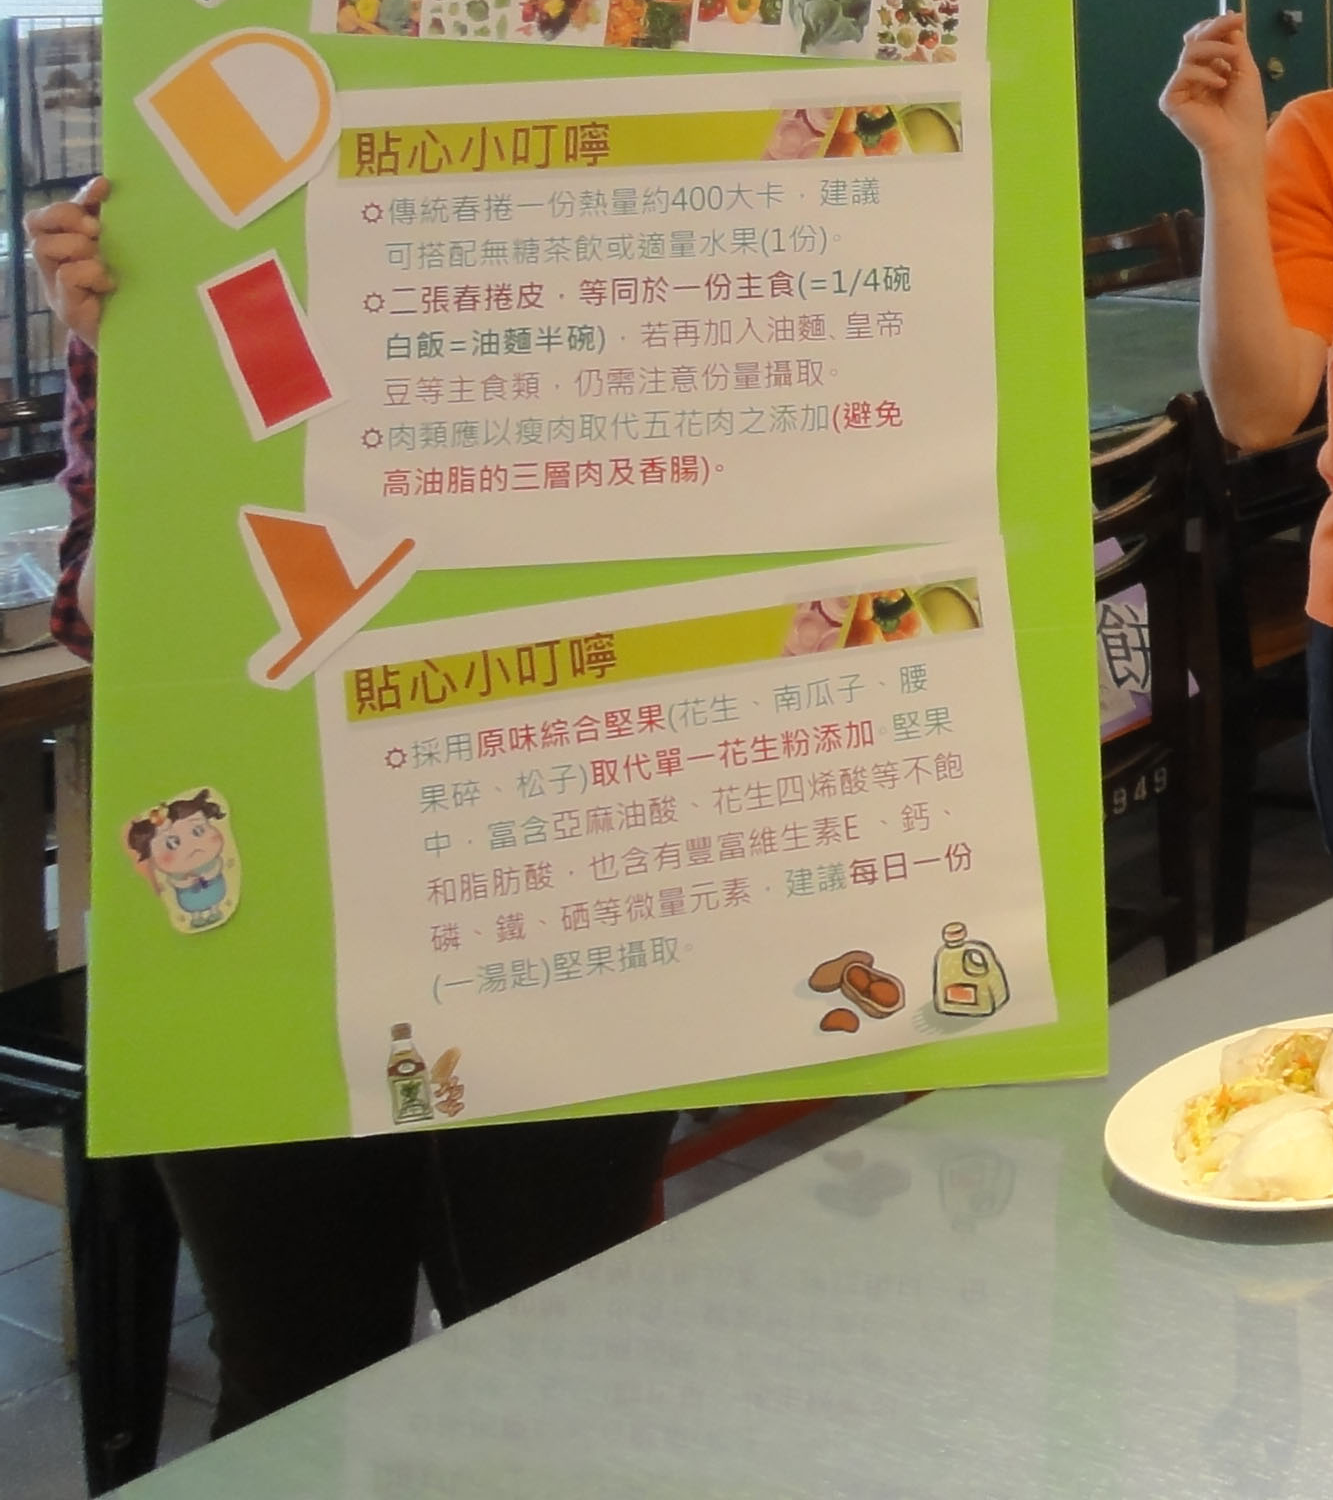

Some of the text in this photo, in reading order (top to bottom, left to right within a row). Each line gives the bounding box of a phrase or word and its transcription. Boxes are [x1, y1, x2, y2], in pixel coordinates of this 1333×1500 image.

[354, 120, 612, 178] 貼心小叮嚀
[354, 632, 619, 716] 貼心小叮嚀
